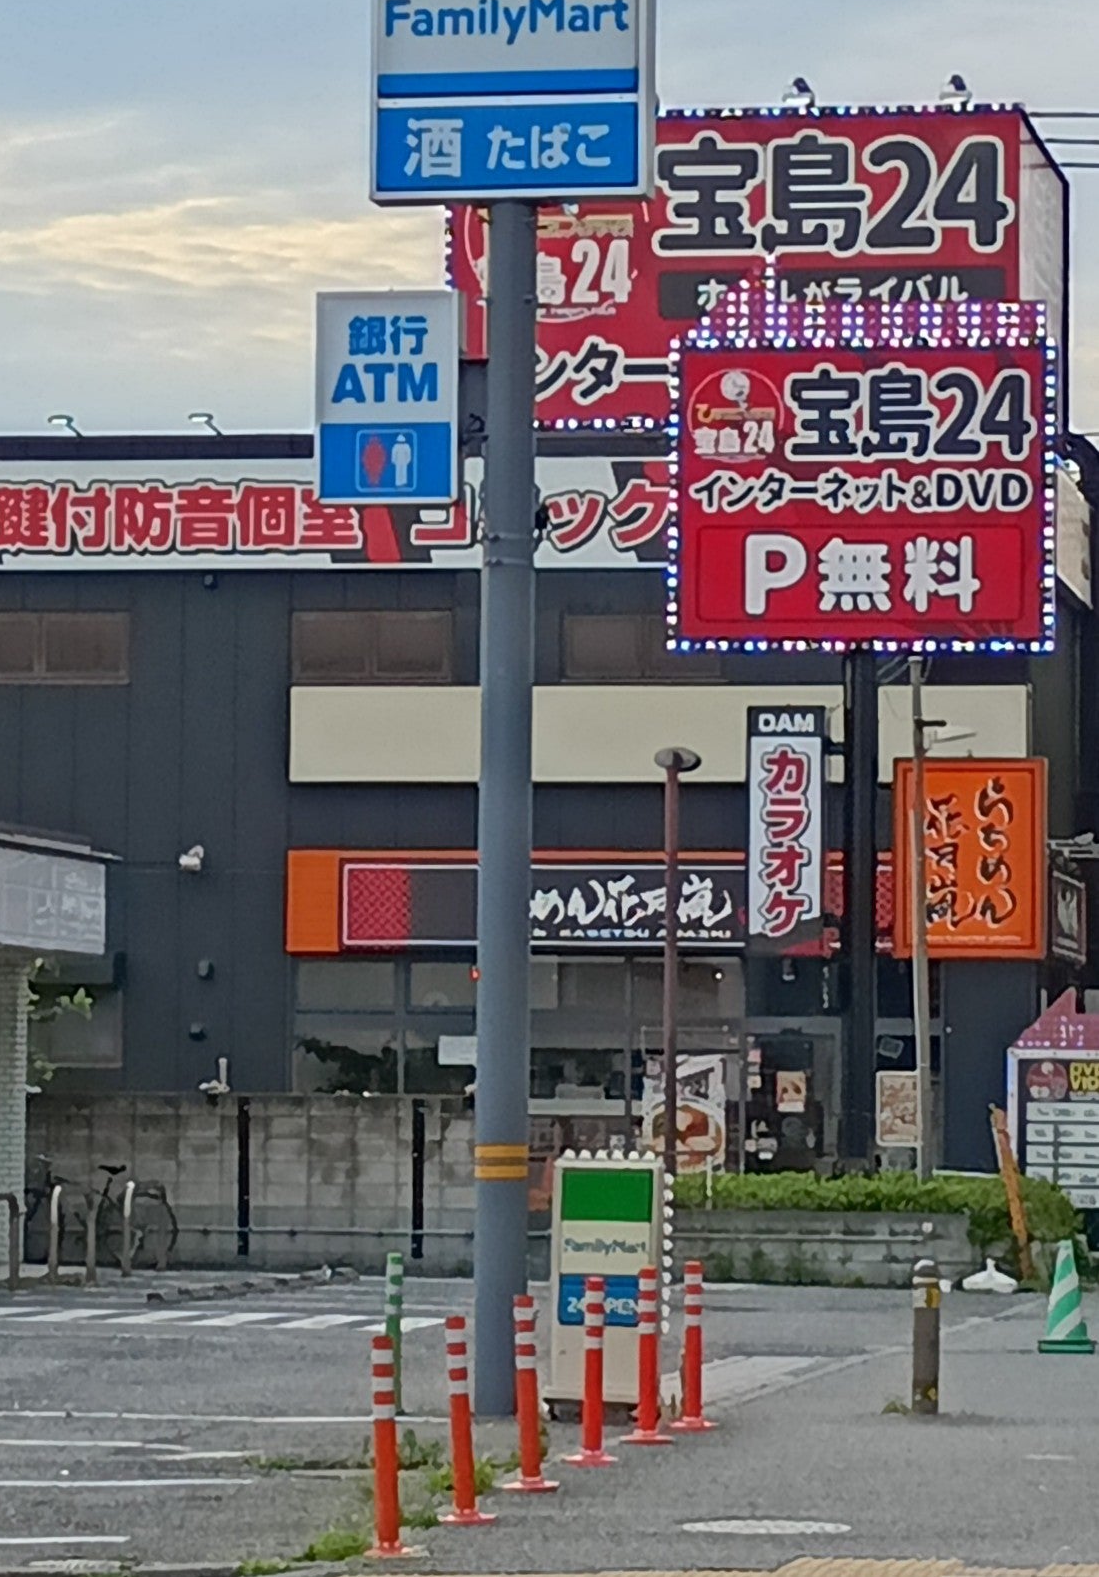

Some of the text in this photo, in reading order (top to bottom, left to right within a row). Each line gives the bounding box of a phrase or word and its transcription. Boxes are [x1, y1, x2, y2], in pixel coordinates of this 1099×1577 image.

[403, 118, 611, 177] 酒 たばこ
[655, 132, 1010, 253] 宝島24
[348, 315, 428, 355] 銀行
[331, 362, 438, 403] ATM
[789, 372, 1031, 458] 宝島24
[695, 472, 1031, 512] インターネット&DVD
[745, 536, 980, 614] P 無料
[759, 714, 814, 732] DAM
[764, 749, 805, 934] カラオケ
